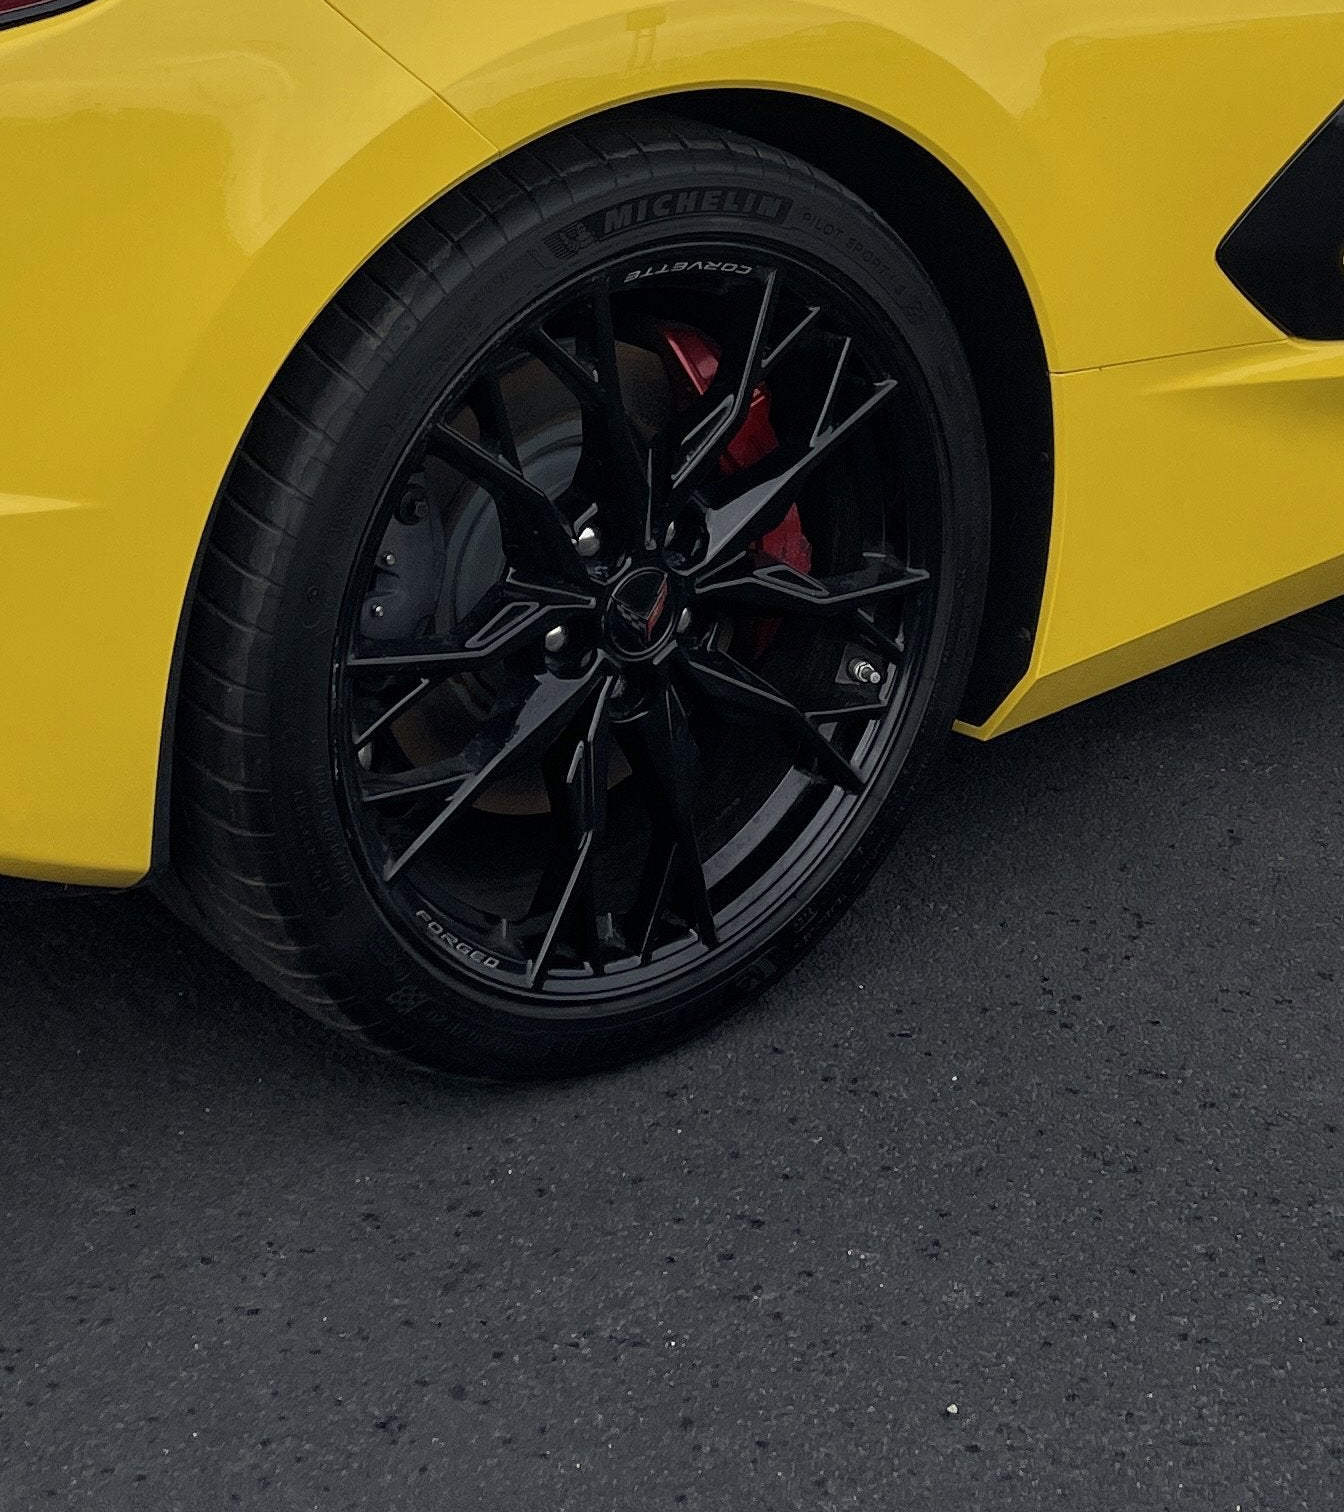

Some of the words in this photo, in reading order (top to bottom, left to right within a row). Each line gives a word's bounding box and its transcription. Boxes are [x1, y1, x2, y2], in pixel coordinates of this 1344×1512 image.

[603, 189, 782, 235] MICHELIN
[800, 211, 844, 239] PILOT
[845, 236, 890, 278] SPORT
[623, 259, 753, 284] CORVETTE
[415, 909, 501, 969] FORGED
